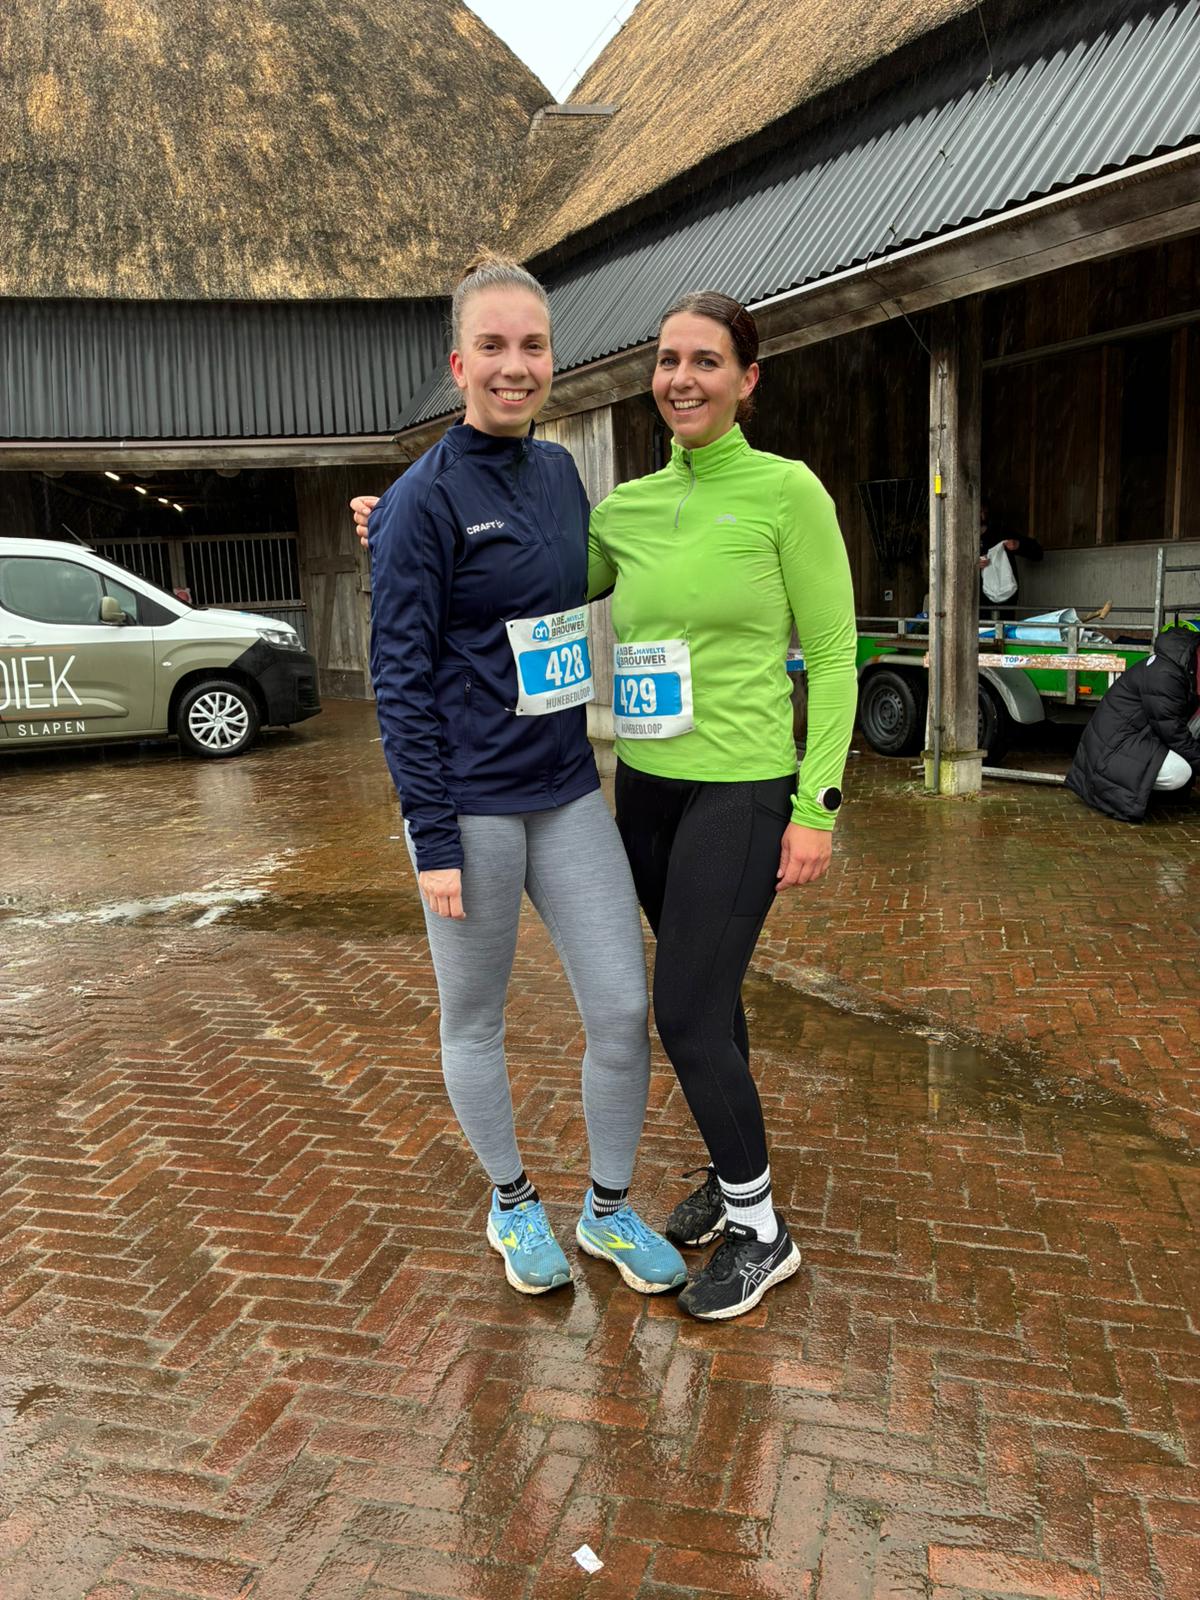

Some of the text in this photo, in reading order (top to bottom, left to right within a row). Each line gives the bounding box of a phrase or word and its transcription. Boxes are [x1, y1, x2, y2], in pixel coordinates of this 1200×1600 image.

[467, 521, 495, 535] CRAFT
[551, 620, 585, 637] BROUWER
[545, 643, 585, 686] 428
[620, 654, 666, 666] BROUWER
[546, 687, 591, 709] HUNEBEDLOOP
[620, 677, 657, 714] 429
[18, 721, 85, 736] SLAPEN
